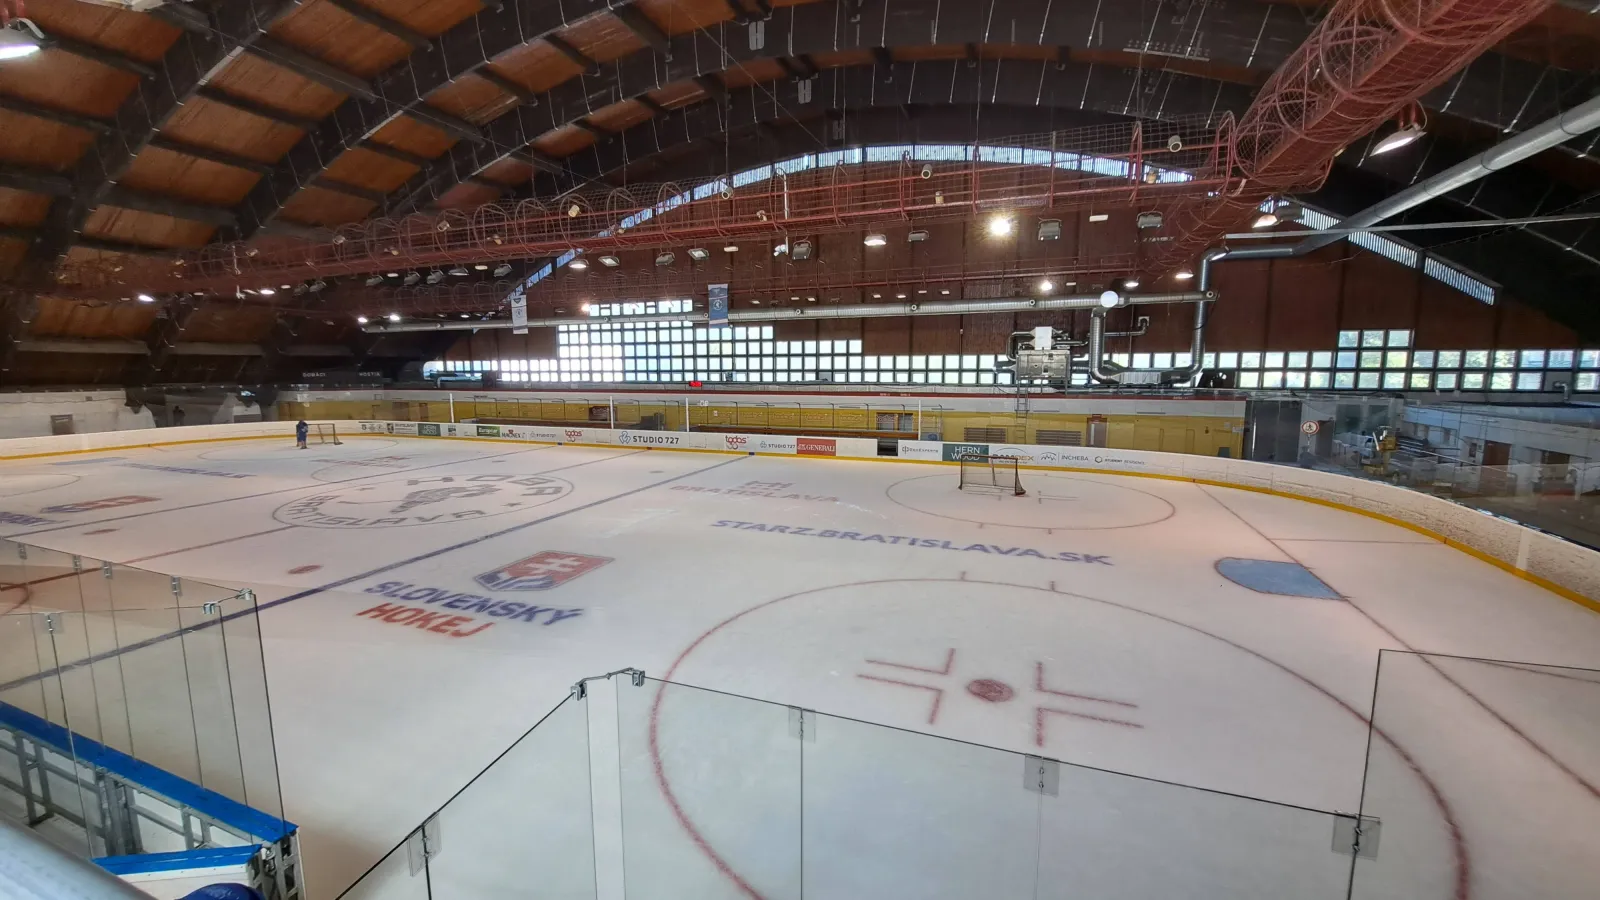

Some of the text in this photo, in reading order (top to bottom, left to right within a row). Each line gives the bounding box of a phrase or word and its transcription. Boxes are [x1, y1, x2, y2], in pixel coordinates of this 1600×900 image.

[632, 435, 680, 445] STUDIO 727
[805, 443, 836, 452] GENERALI
[953, 446, 981, 454] HERN
[950, 452, 981, 461] WOOD
[1061, 454, 1089, 462] INCHEBA
[669, 485, 840, 502] BRATISLAVA
[709, 519, 1115, 567] STARZ.BRATISLAVA.SK
[363, 580, 585, 626] SLOVENSKÝ
[356, 602, 496, 638] HOKEJ
